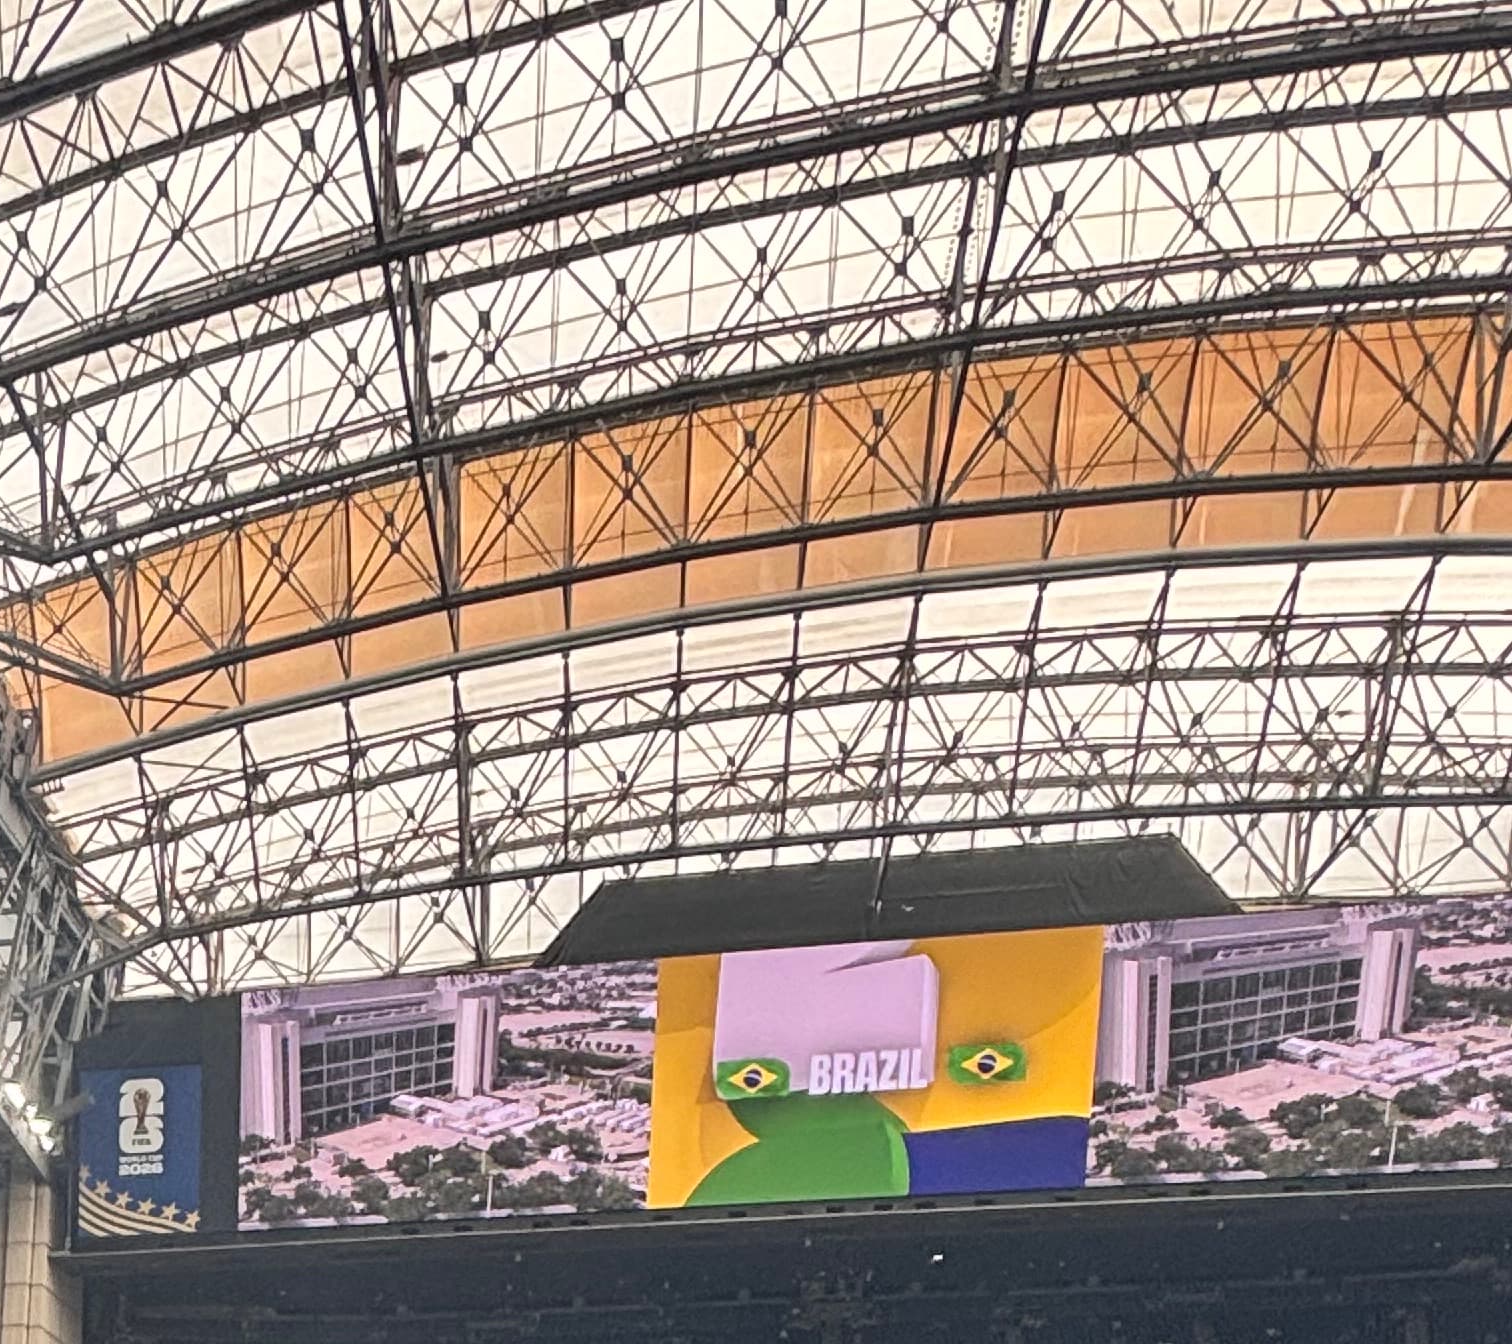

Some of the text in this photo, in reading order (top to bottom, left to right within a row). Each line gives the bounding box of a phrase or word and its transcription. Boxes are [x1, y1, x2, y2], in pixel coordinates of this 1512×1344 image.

[808, 1048, 928, 1095] BRAZIL
[131, 1138, 151, 1146] FIFA
[119, 1162, 164, 1176] 2026
